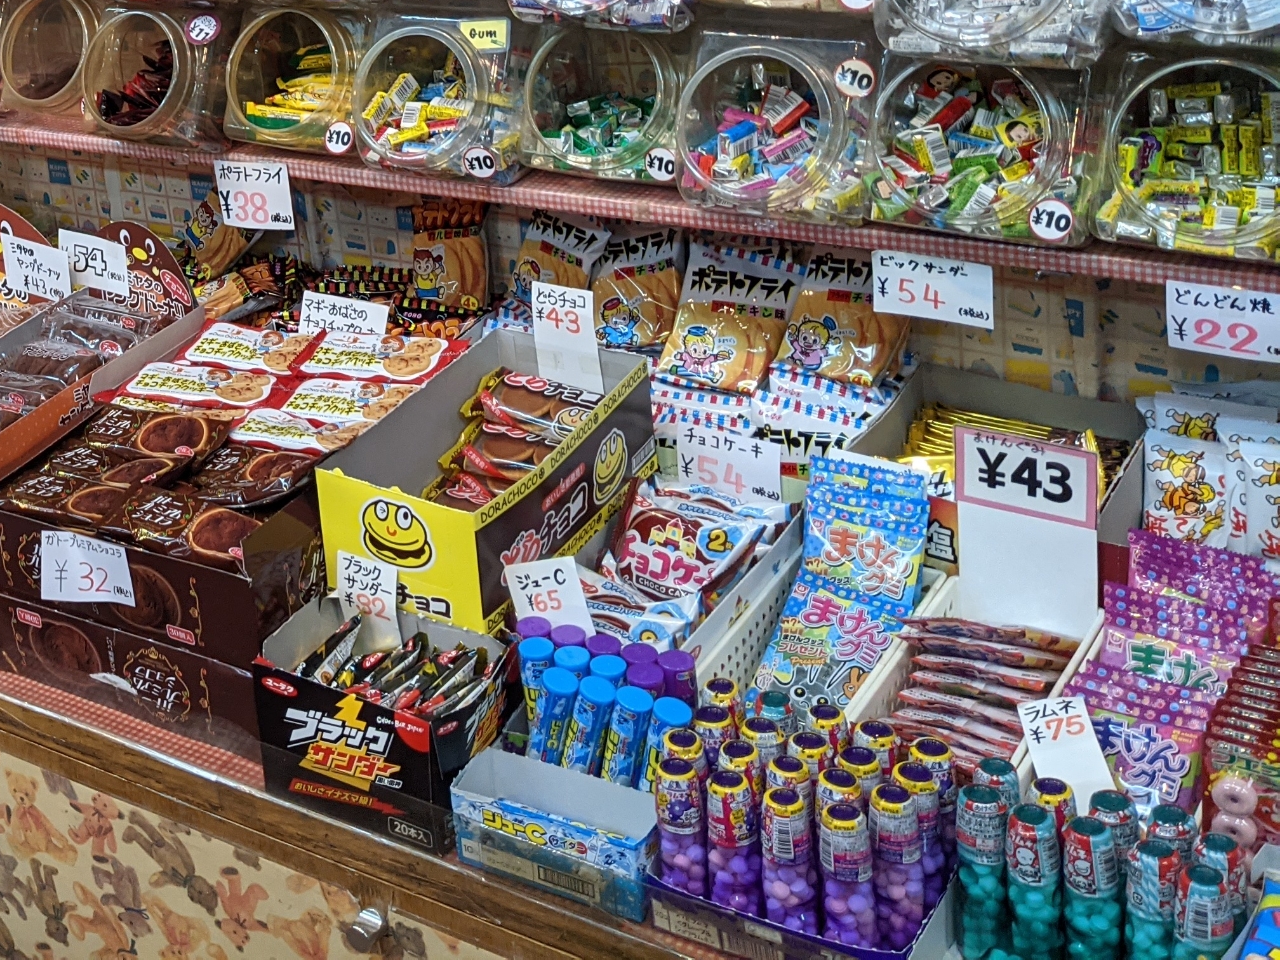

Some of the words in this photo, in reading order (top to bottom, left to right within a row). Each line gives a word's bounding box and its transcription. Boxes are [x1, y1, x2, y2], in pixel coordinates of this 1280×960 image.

[838, 68, 874, 88] ¥10
[326, 130, 351, 148] ¥10
[218, 165, 284, 186] ポテトフライ
[467, 155, 496, 172] ¥10
[647, 155, 675, 174] ¥10
[218, 189, 269, 225] ¥38
[530, 209, 600, 252] ポテトフライ
[1032, 209, 1070, 232] ¥10
[879, 254, 969, 278] ビックサンダー
[23, 274, 47, 292] ¥43
[690, 264, 797, 304] ポテトフライ
[877, 276, 946, 311] ¥54
[536, 288, 586, 309] どらチョコ
[1175, 287, 1275, 315] どんどん焼
[535, 307, 581, 334] ¥43
[1172, 315, 1261, 356] ¥22
[603, 366, 643, 414] DORACHOCO
[550, 418, 594, 469] DORACHOCO
[683, 427, 763, 459] チョコケーキ
[972, 431, 1046, 455] まけんぐみ
[681, 453, 747, 495] ¥54
[976, 447, 1074, 504] ¥43
[480, 475, 539, 524] DORACHOCO
[45, 534, 122, 558] ガトープレミアムショコラ
[55, 560, 111, 593] ¥32
[342, 556, 382, 579] ブラック
[515, 569, 567, 590] ジューC
[344, 575, 393, 597] サンダー
[638, 576, 666, 594] CHOCO
[525, 589, 562, 613] ¥65
[801, 592, 894, 648] まけん
[777, 642, 828, 658] プレゼント
[791, 656, 826, 666] Present
[835, 636, 884, 668] グミ
[265, 678, 295, 696] ユーラク
[1024, 698, 1077, 724] ラムネ
[283, 707, 394, 757] ブラック
[1028, 713, 1086, 744] ¥75
[308, 742, 402, 778] サンダー
[294, 782, 373, 807] おいしさイナズマ級!
[393, 822, 426, 842] 20本入
[481, 808, 548, 847] ジューC
